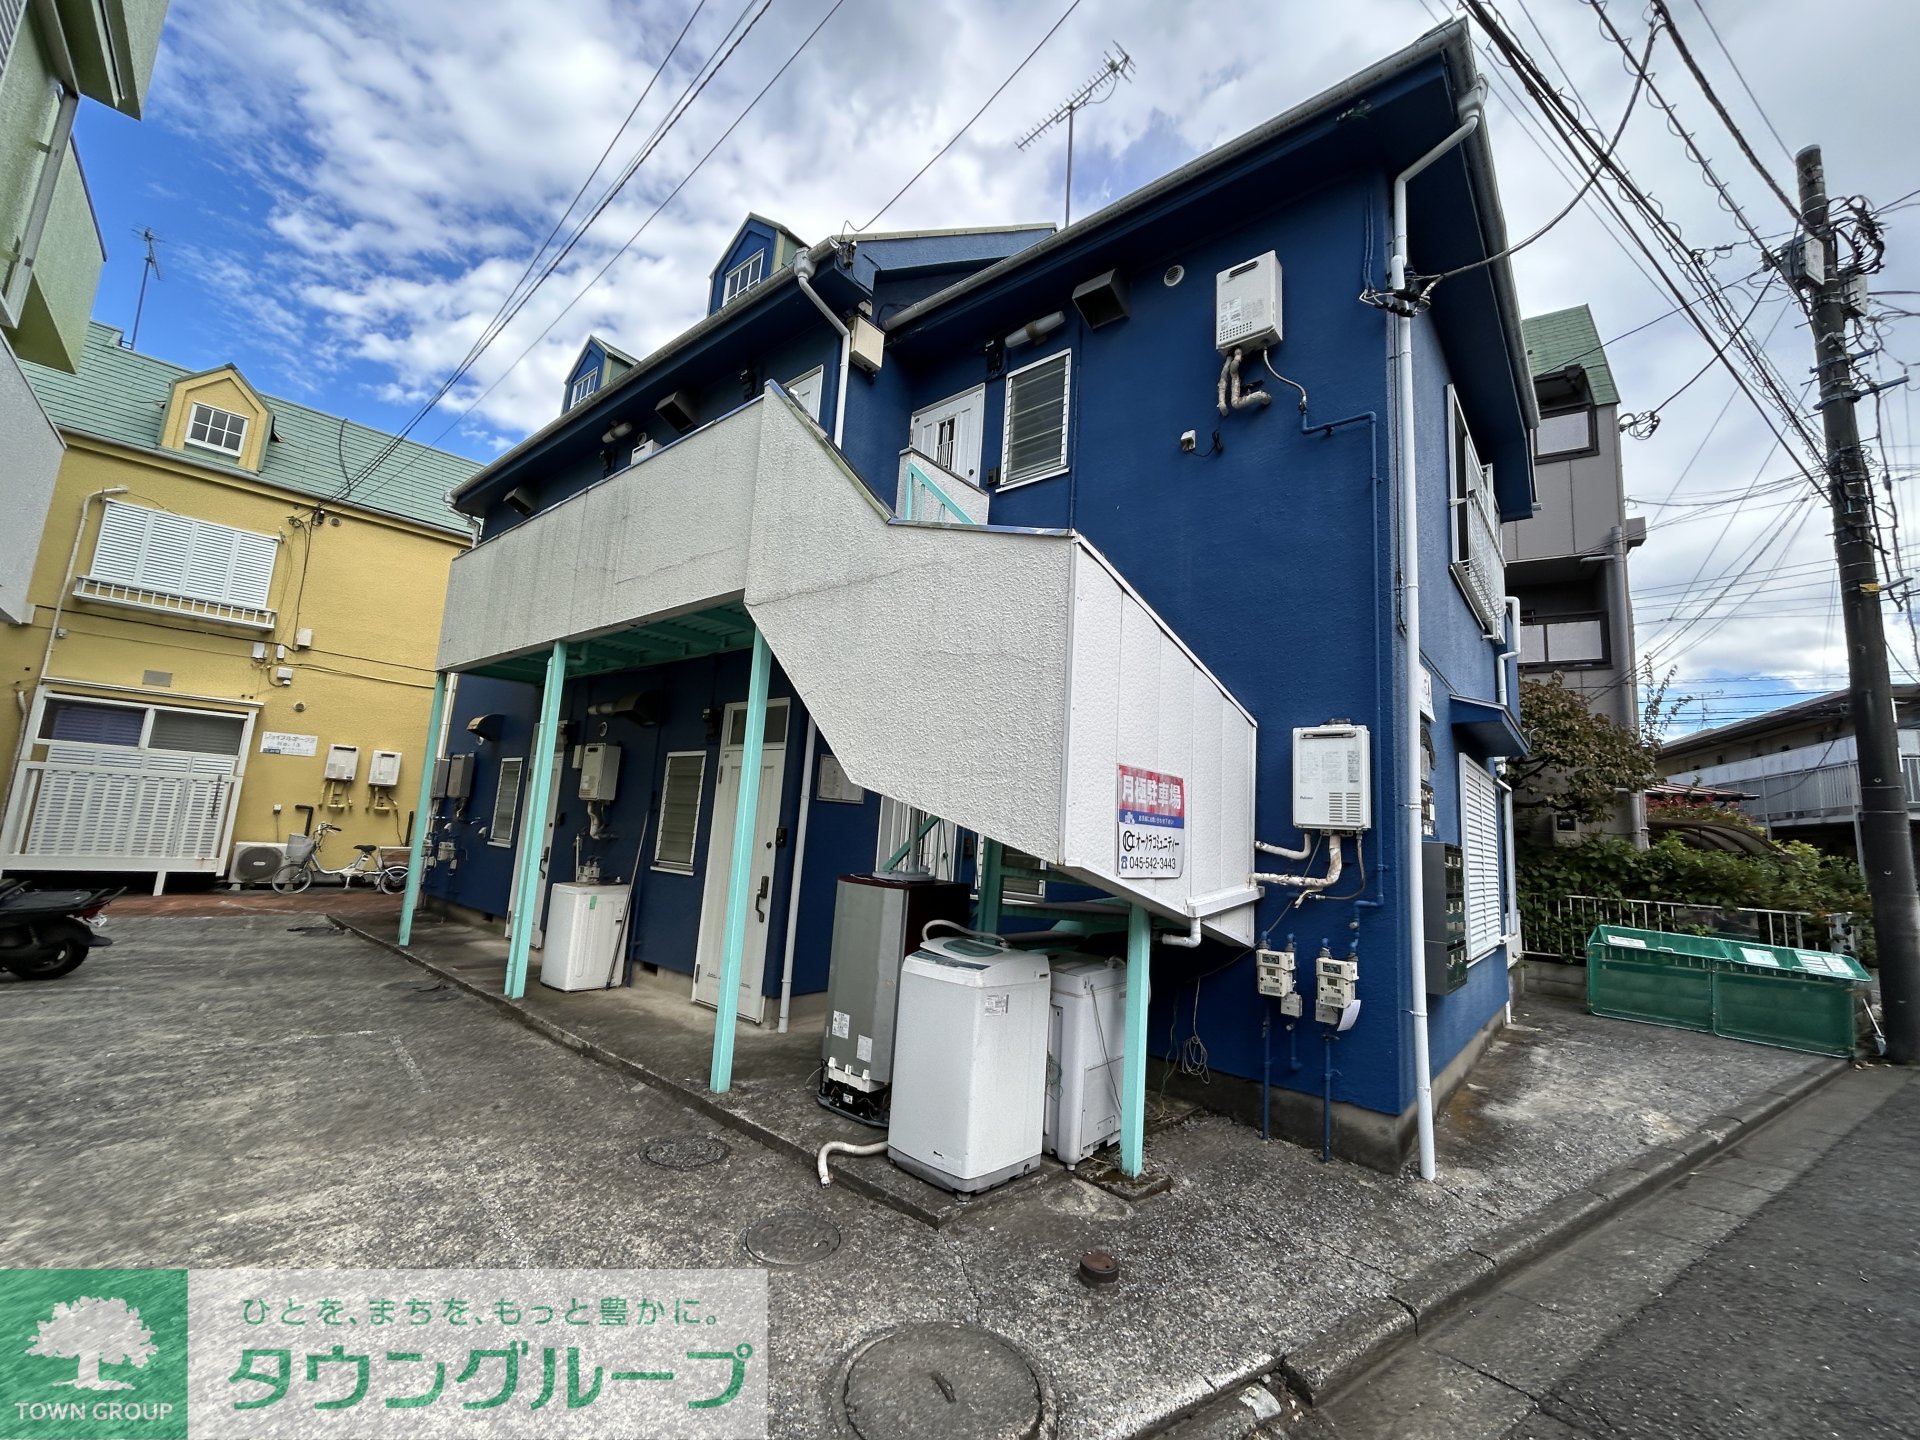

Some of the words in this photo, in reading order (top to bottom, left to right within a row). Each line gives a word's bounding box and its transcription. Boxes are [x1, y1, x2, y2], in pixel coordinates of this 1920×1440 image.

[1122, 775, 1181, 809] 月極駐車場
[1129, 855, 1176, 870] 045-542-3443
